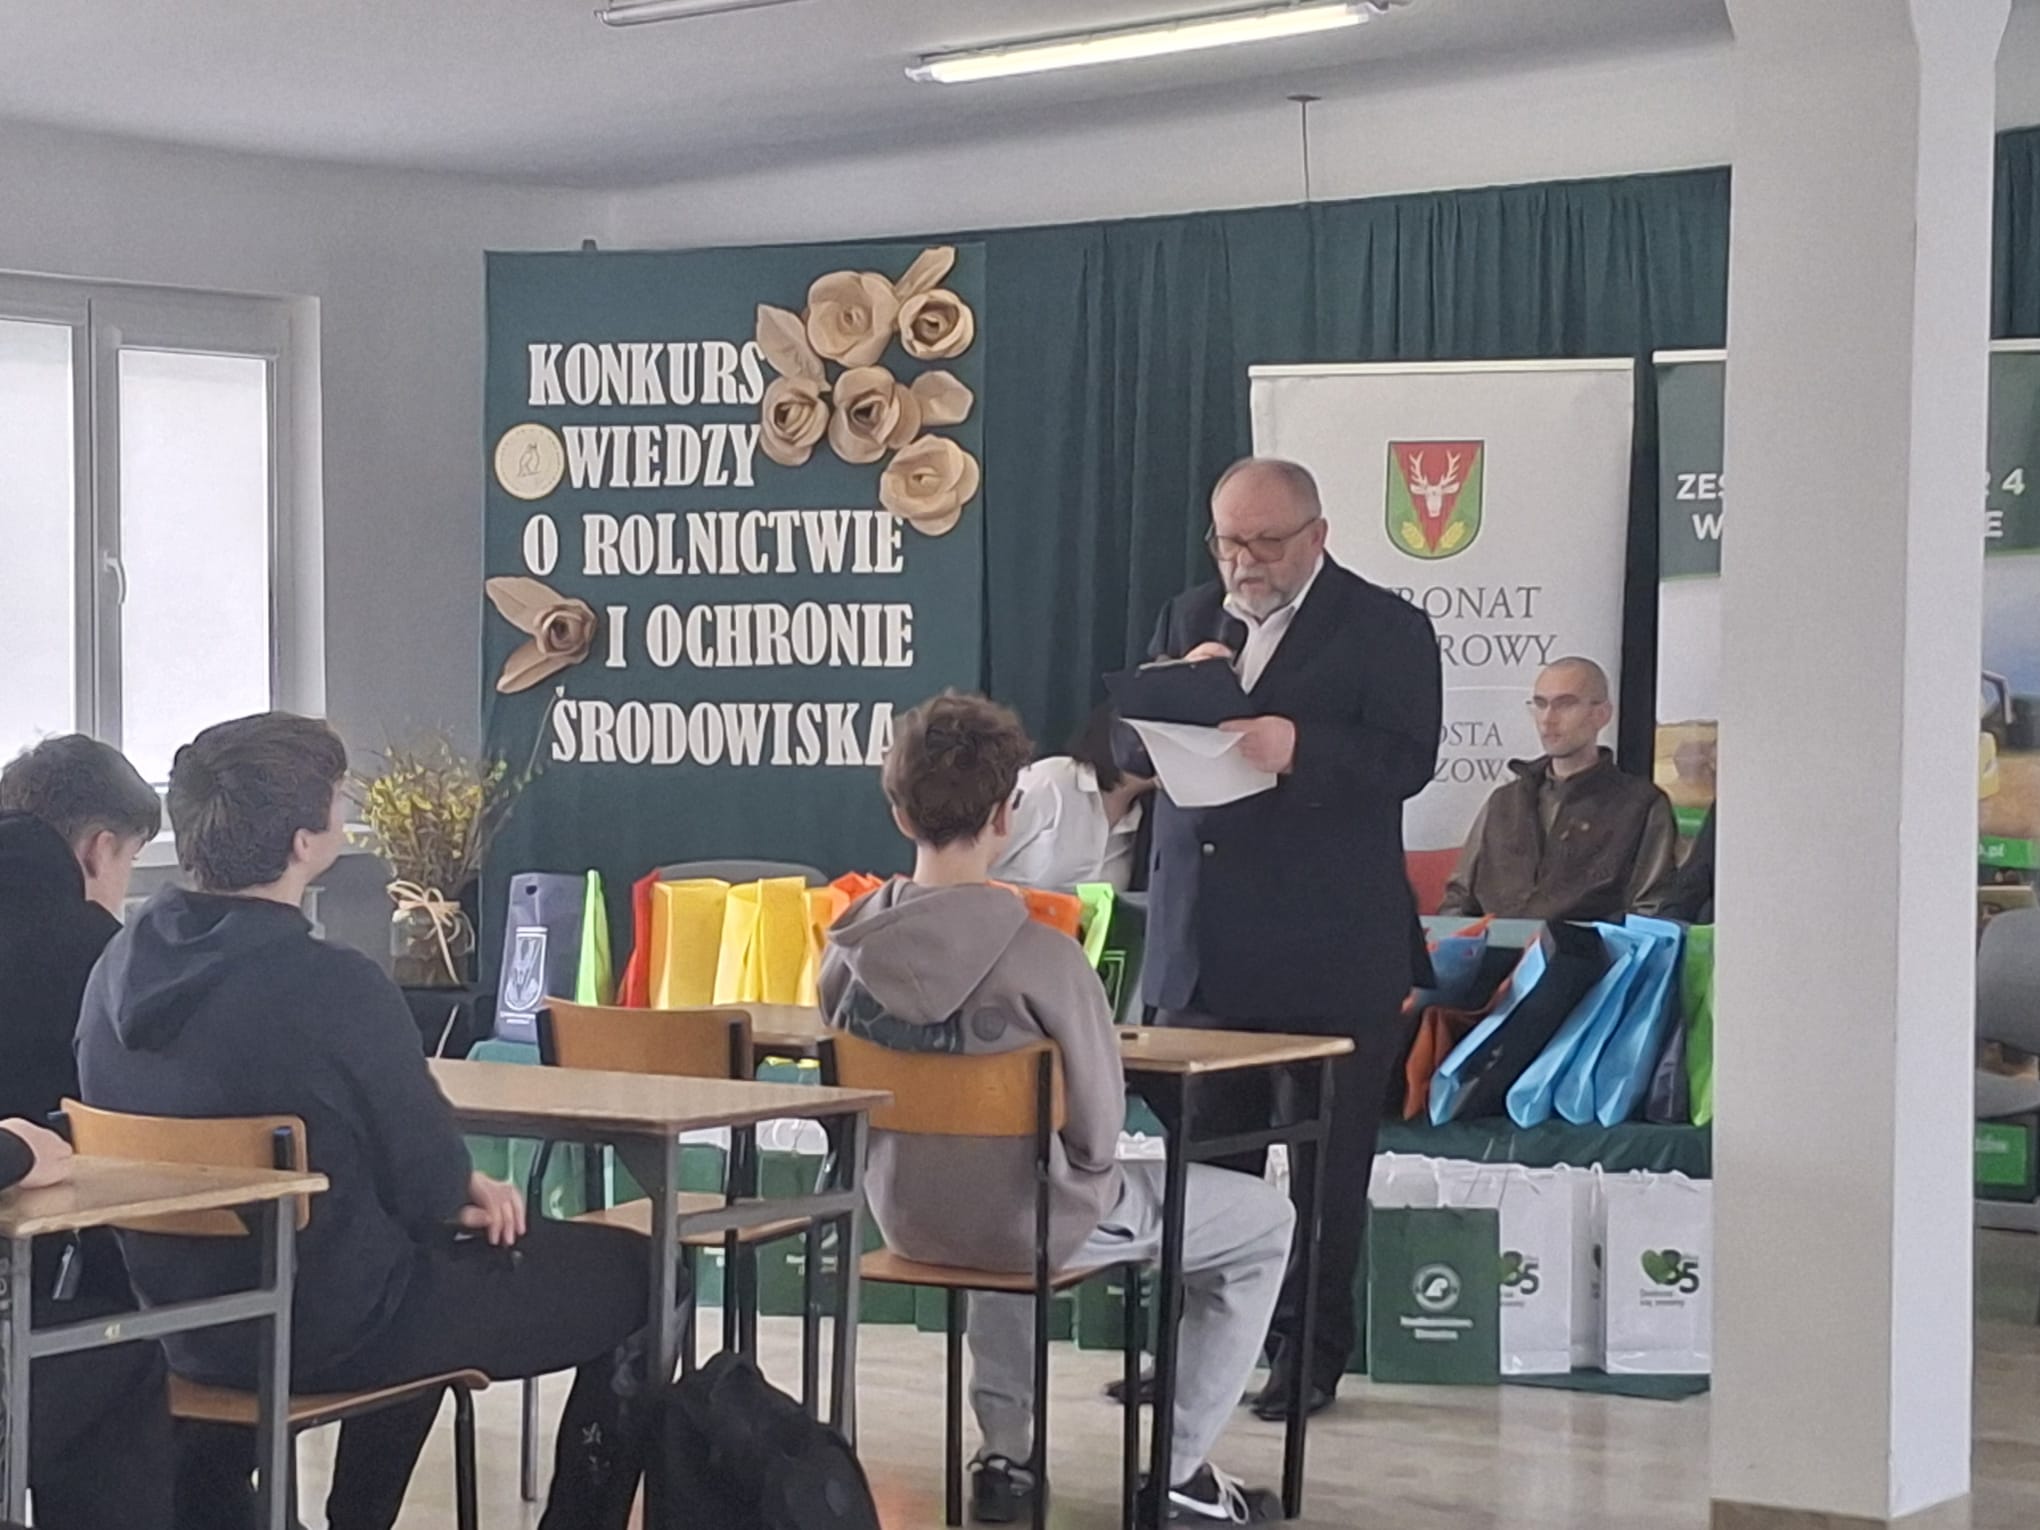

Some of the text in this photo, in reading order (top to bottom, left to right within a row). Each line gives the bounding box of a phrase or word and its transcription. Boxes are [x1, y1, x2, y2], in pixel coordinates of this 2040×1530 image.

[528, 341, 765, 405] KONKURS
[562, 424, 761, 488] WIEDZY
[2002, 467, 2026, 496] 4
[523, 510, 903, 575] O ROLNICTWIE
[605, 602, 913, 667] I OCHRONIE
[552, 685, 894, 766] ŚRODOWISKA
